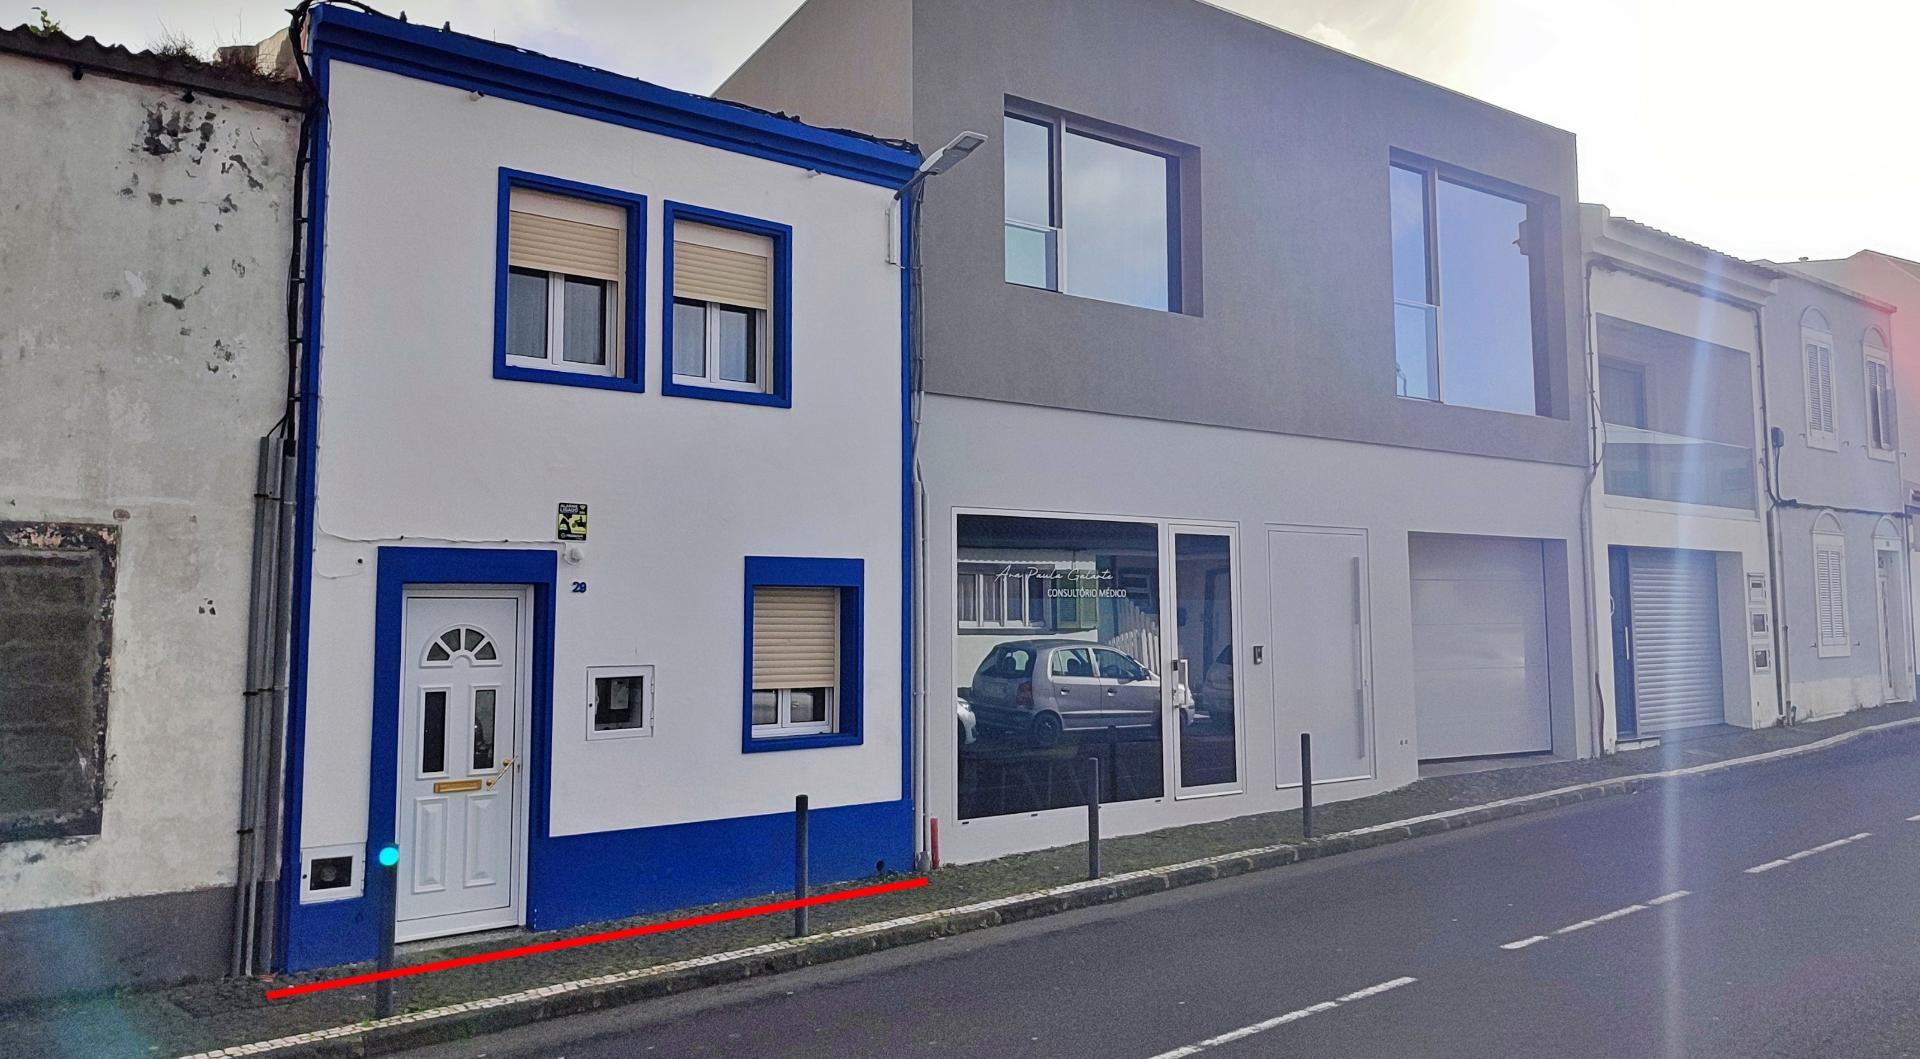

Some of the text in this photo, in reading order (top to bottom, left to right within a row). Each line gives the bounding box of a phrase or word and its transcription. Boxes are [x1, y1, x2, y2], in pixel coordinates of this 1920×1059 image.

[993, 564, 1114, 582] Ana Paula Galante
[572, 581, 587, 593] 29
[1047, 587, 1127, 598] CONSULTÓRIO MÉDICO
